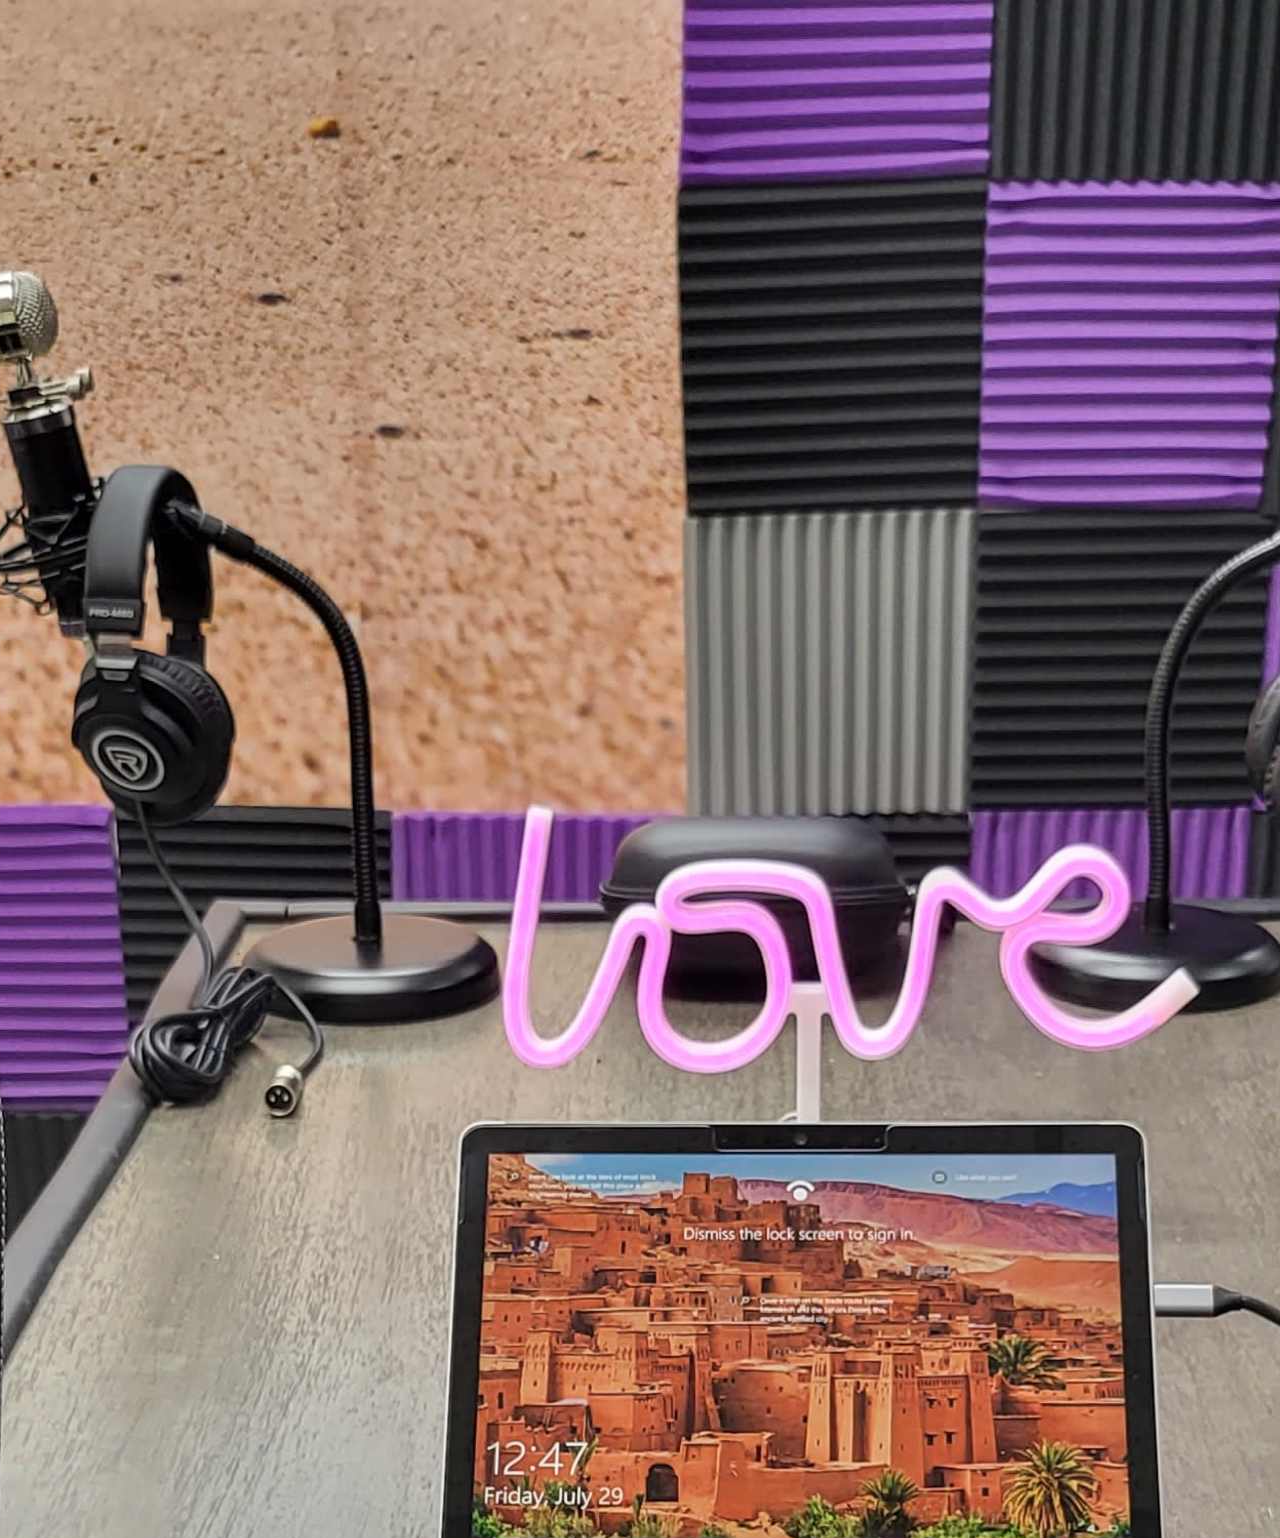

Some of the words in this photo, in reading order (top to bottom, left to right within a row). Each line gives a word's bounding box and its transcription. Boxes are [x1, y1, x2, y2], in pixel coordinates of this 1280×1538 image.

[683, 1227, 735, 1240] Dismiss
[740, 1227, 762, 1240] the
[766, 1227, 795, 1240] lock
[798, 1229, 844, 1240] screen
[848, 1228, 862, 1240] to
[867, 1227, 895, 1244] sign
[487, 1441, 588, 1475] 12:47
[484, 1486, 548, 1509] Friday,
[554, 1486, 592, 1510] July
[598, 1487, 624, 1505] 29
